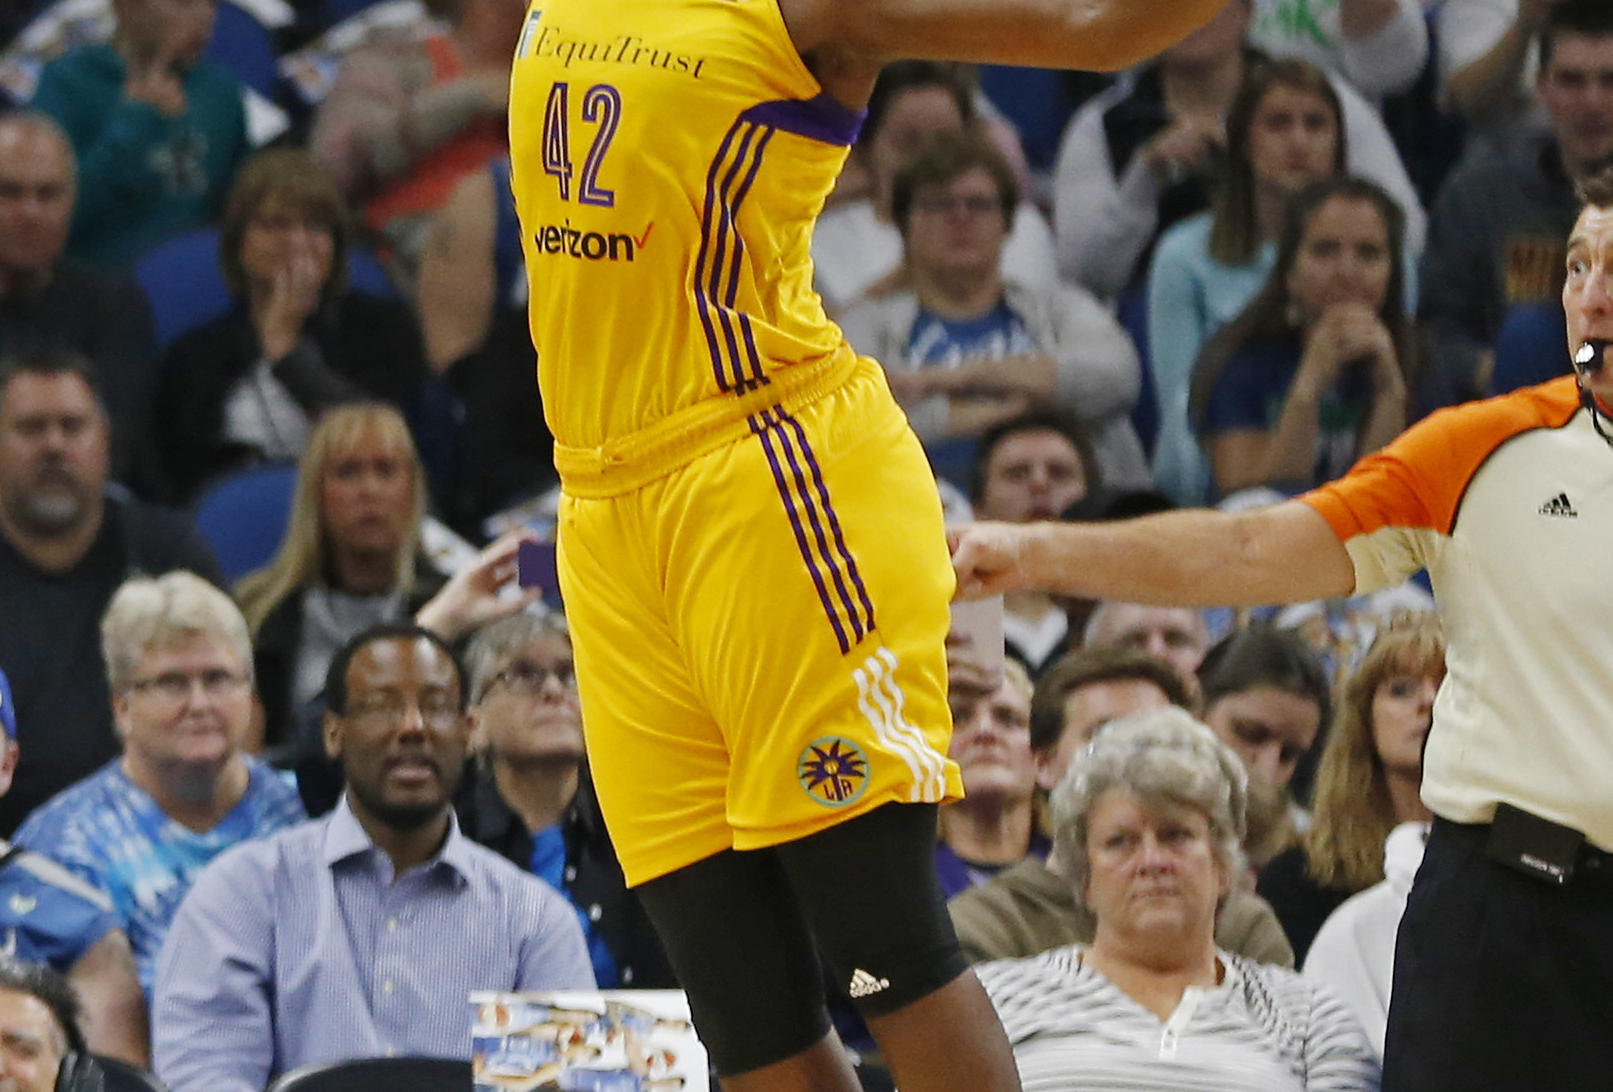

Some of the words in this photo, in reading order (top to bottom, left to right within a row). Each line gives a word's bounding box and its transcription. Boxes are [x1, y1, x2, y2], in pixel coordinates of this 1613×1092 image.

[536, 26, 706, 79] EquiTrust
[542, 82, 622, 208] 42
[535, 219, 634, 262] verizon
